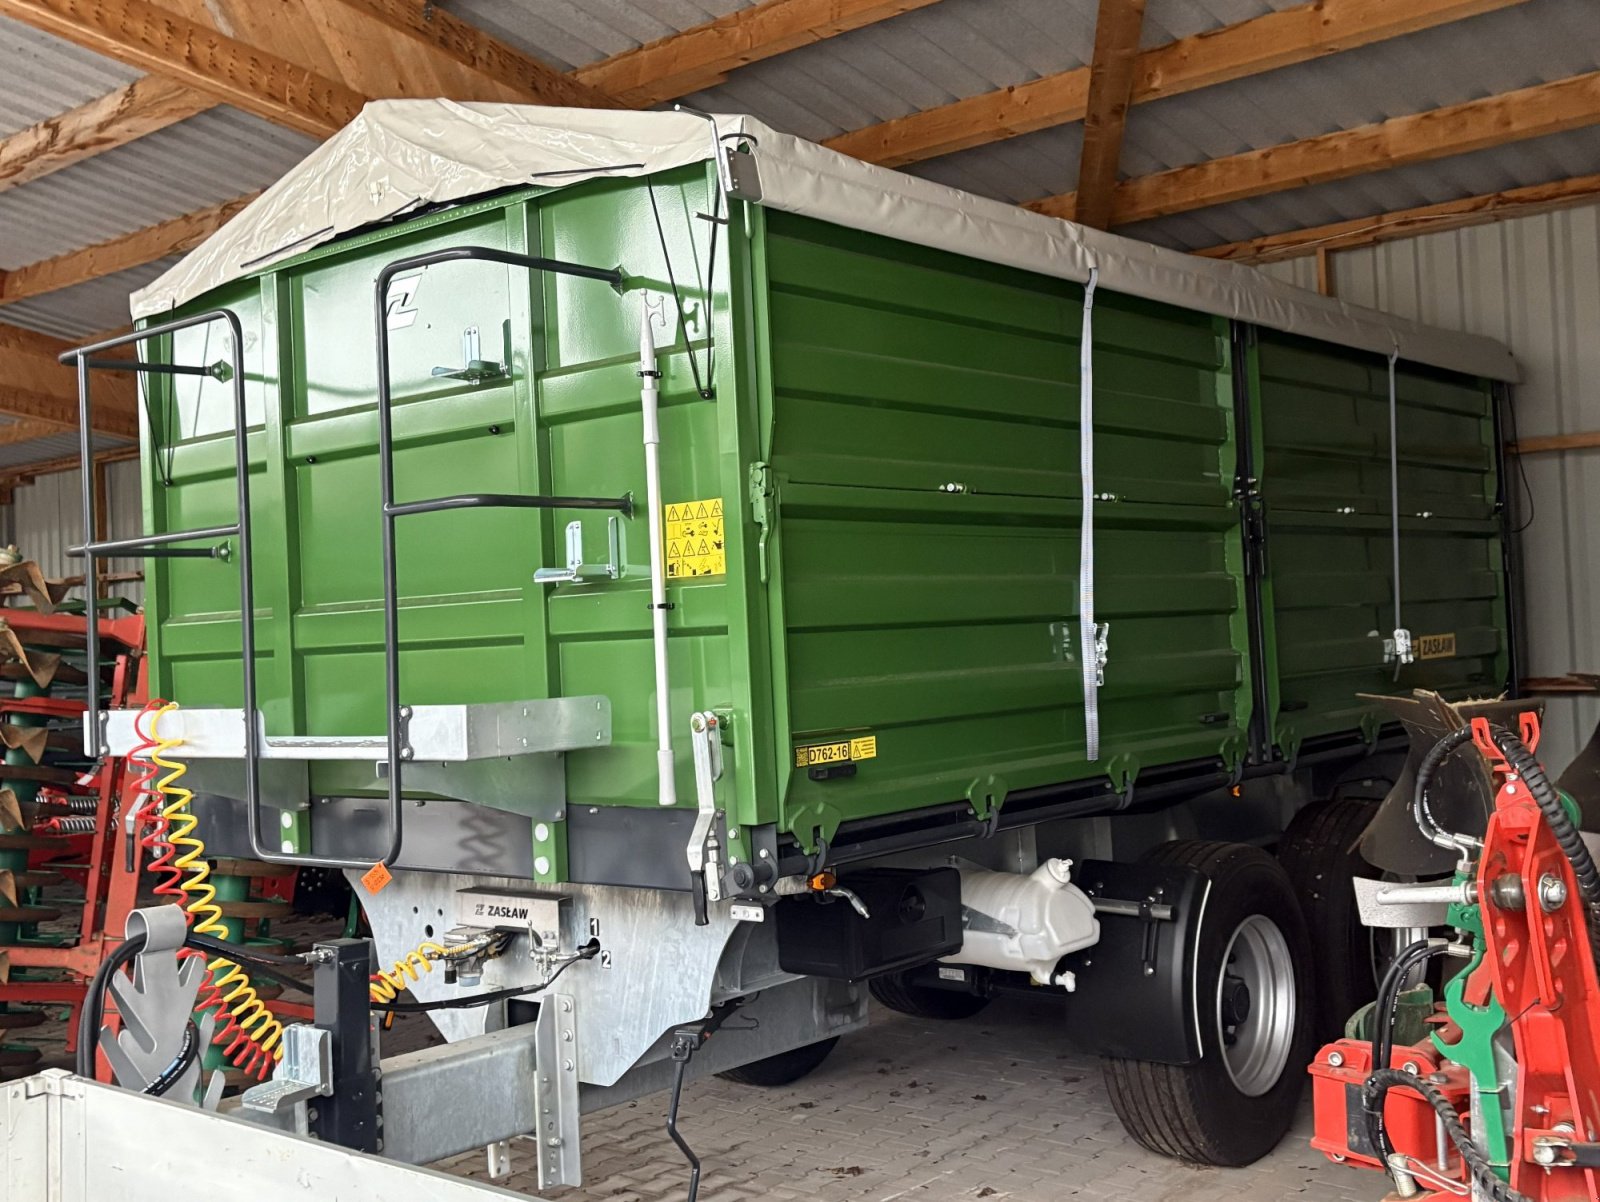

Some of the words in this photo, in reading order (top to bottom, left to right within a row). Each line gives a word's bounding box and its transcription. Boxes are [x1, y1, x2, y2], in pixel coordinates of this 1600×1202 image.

[809, 745, 848, 762] D762-16
[488, 905, 529, 920] ZASŁAW
[591, 919, 599, 936] 1
[602, 951, 611, 968] 2
